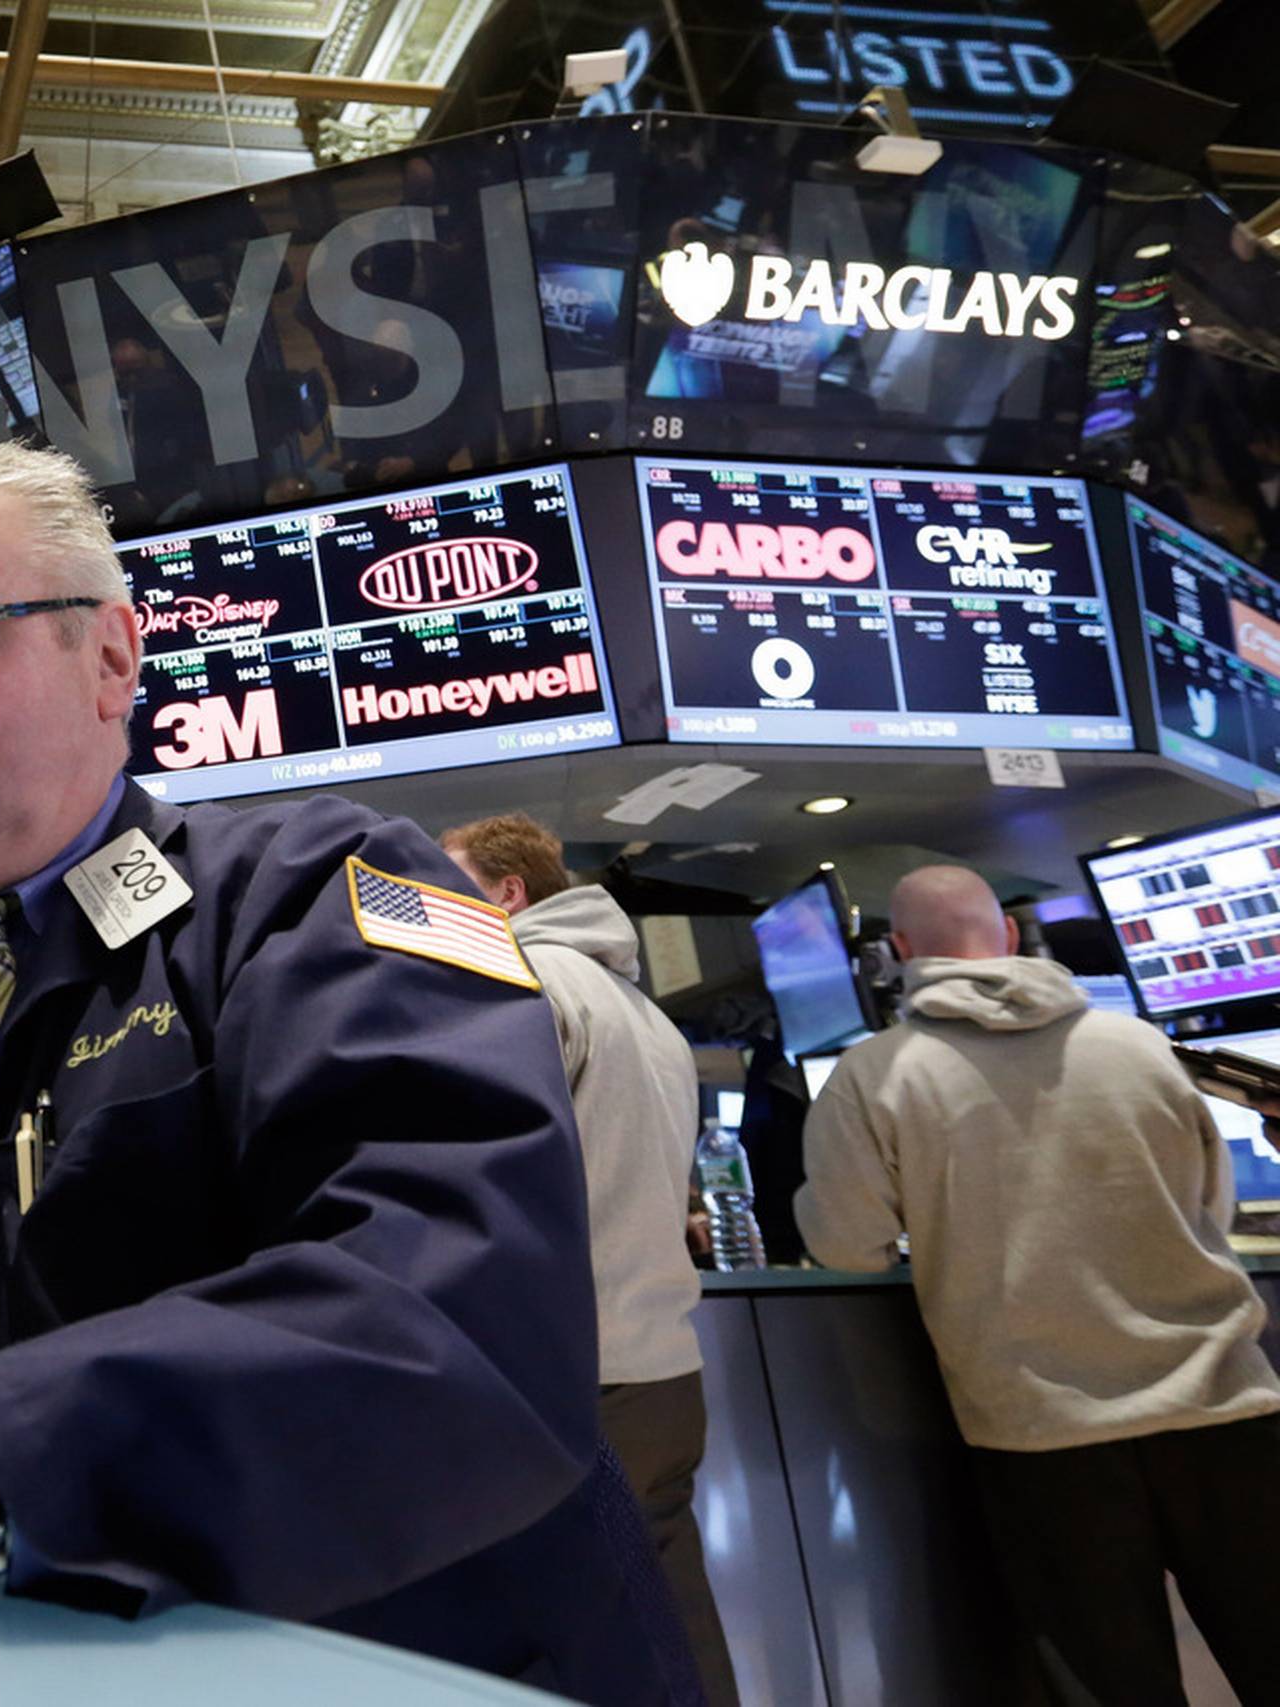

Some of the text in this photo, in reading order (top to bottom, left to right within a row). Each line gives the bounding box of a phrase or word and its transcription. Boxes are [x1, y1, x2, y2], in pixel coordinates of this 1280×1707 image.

[772, 26, 1073, 97] LISTED
[745, 255, 1078, 340] BARCLAYS
[652, 415, 684, 440] 8B
[320, 516, 336, 529] DD
[657, 520, 875, 582] CARBO
[916, 524, 1019, 565] CVR
[144, 588, 173, 604] The
[950, 560, 1052, 595] refining
[195, 623, 263, 643] Company
[983, 643, 1026, 665] SIX
[342, 652, 598, 726] Honeywell
[985, 694, 1039, 713] NYSE
[153, 688, 283, 770] 3M
[111, 849, 166, 902] 209
